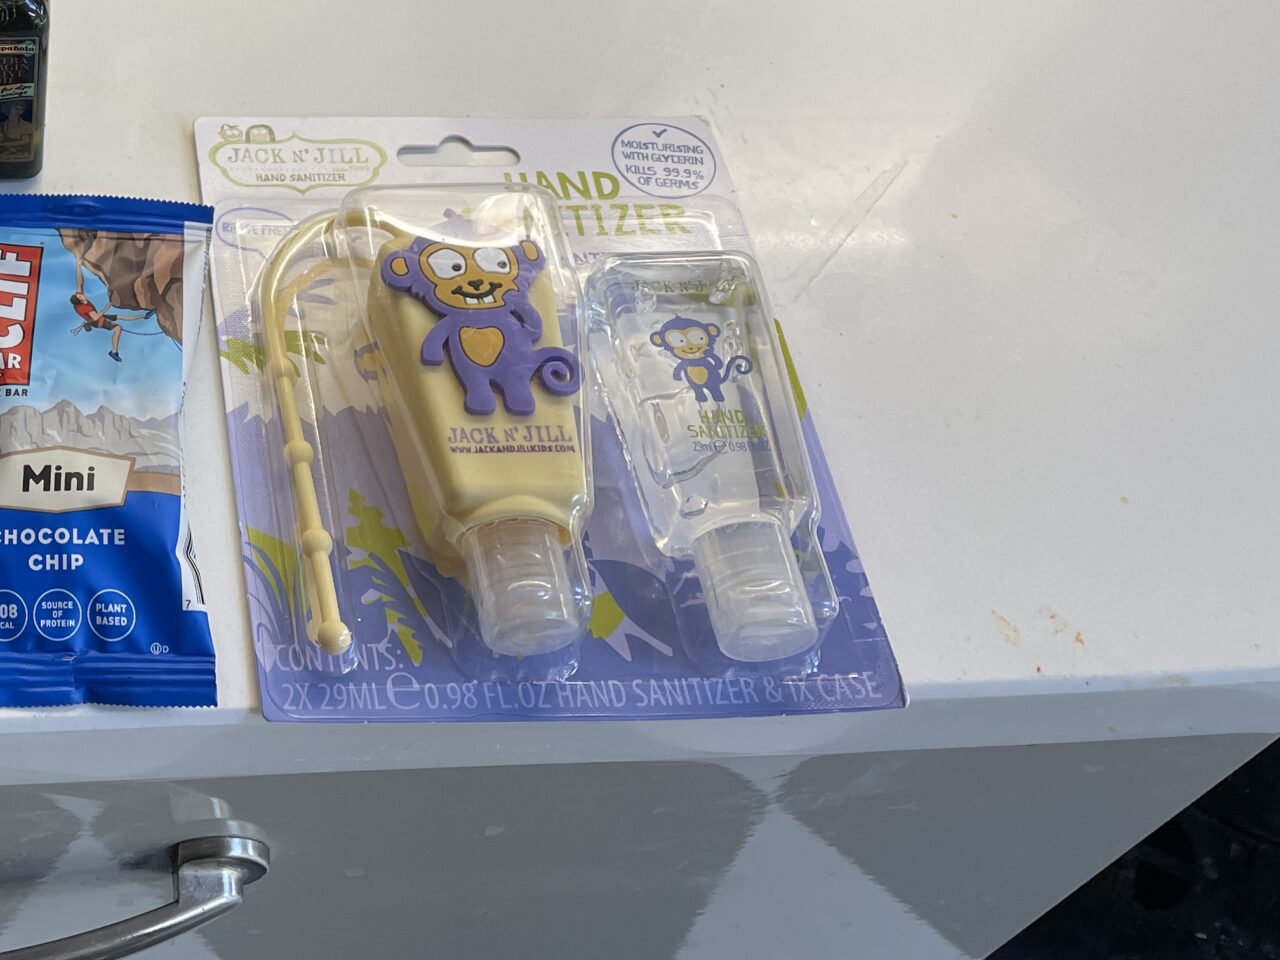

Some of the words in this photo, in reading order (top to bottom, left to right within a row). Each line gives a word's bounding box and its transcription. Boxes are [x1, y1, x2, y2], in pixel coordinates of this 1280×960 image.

[620, 139, 703, 155] MOISTURISING
[227, 148, 285, 164] JACK
[313, 147, 369, 164] JILL
[622, 150, 649, 162] WITH
[651, 153, 704, 166] GLYCERIN
[256, 173, 286, 183] HAND
[289, 172, 346, 183] SANITIZER
[625, 164, 656, 176] KILLS
[663, 167, 705, 180] 99.9%
[503, 170, 621, 201] HAND
[637, 176, 653, 186] OF
[655, 178, 699, 190] GERMS
[5, 388, 29, 398] BAR
[448, 426, 500, 444] JACK
[523, 425, 573, 443] JILL
[22, 464, 96, 493] Mini
[28, 553, 84, 571] CHIP
[41, 600, 74, 610] SOURCE
[95, 603, 128, 614] PLANT
[52, 610, 64, 618] OF
[96, 616, 128, 627] BASED
[40, 618, 75, 628] PROTEIN
[282, 683, 312, 711] 2X
[424, 682, 478, 711] 0.98
[558, 678, 627, 708] HAND
[632, 675, 758, 708] SANITIZER
[762, 676, 782, 703] &
[816, 671, 882, 701] CASE
